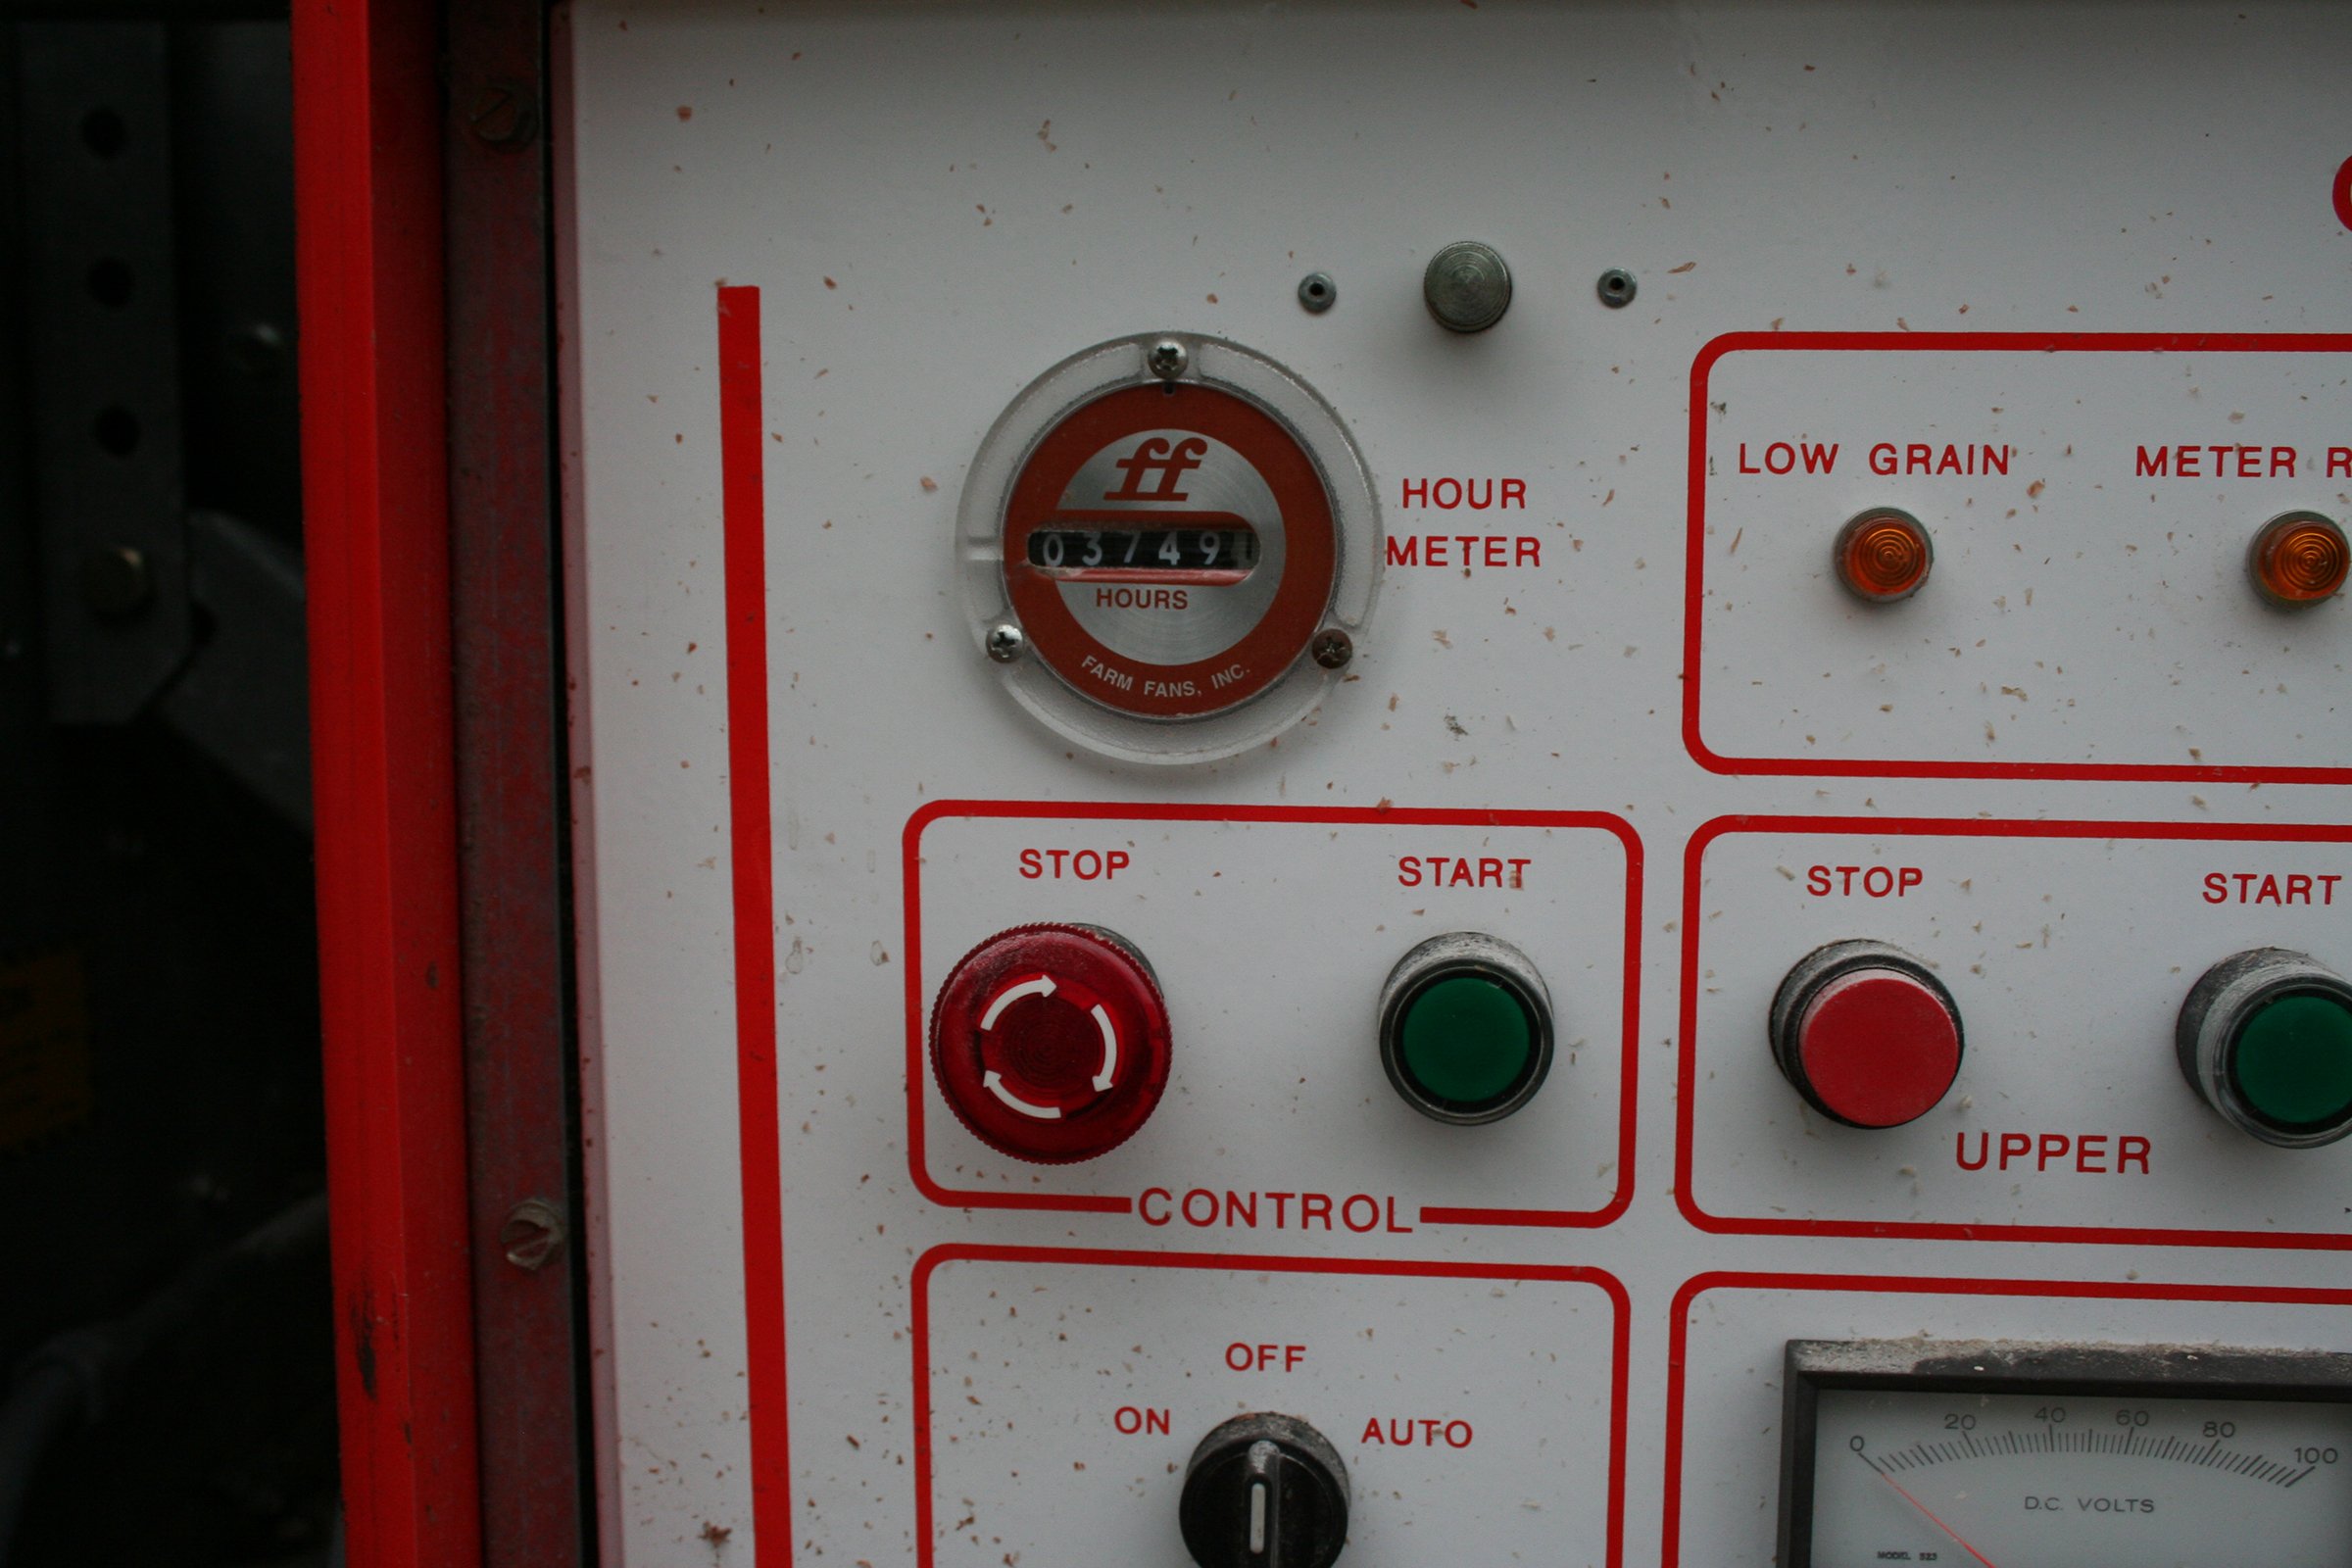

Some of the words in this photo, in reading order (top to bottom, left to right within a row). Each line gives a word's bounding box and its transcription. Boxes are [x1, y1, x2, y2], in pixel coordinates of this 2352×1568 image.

[1740, 442, 1838, 474] LOW
[1869, 443, 2008, 475] GRAIN
[2136, 446, 2296, 477] METER
[1402, 477, 1526, 510] HOUR
[1387, 536, 1541, 566] METER
[1096, 589, 1189, 610] HOURS
[1081, 655, 1133, 690] FARM
[1210, 663, 1250, 689] INC.
[1020, 849, 1129, 880] STOP
[1398, 856, 1531, 889] START
[1807, 865, 1923, 898] STOP
[2203, 872, 2341, 905] START
[1957, 1133, 2150, 1173] UPPER
[1139, 1187, 1411, 1233] CONTROL
[1226, 1343, 1305, 1371] OFF
[1115, 1406, 1169, 1435] ON
[1943, 1414, 1977, 1431] 20
[2033, 1407, 2067, 1424] 40
[2115, 1409, 2149, 1427] 60
[2202, 1421, 2235, 1439] 80
[1362, 1418, 1473, 1448] AUTO
[1848, 1435, 1865, 1453] 0
[2294, 1447, 2338, 1465] 100
[2078, 1496, 2155, 1514] VOLTS
